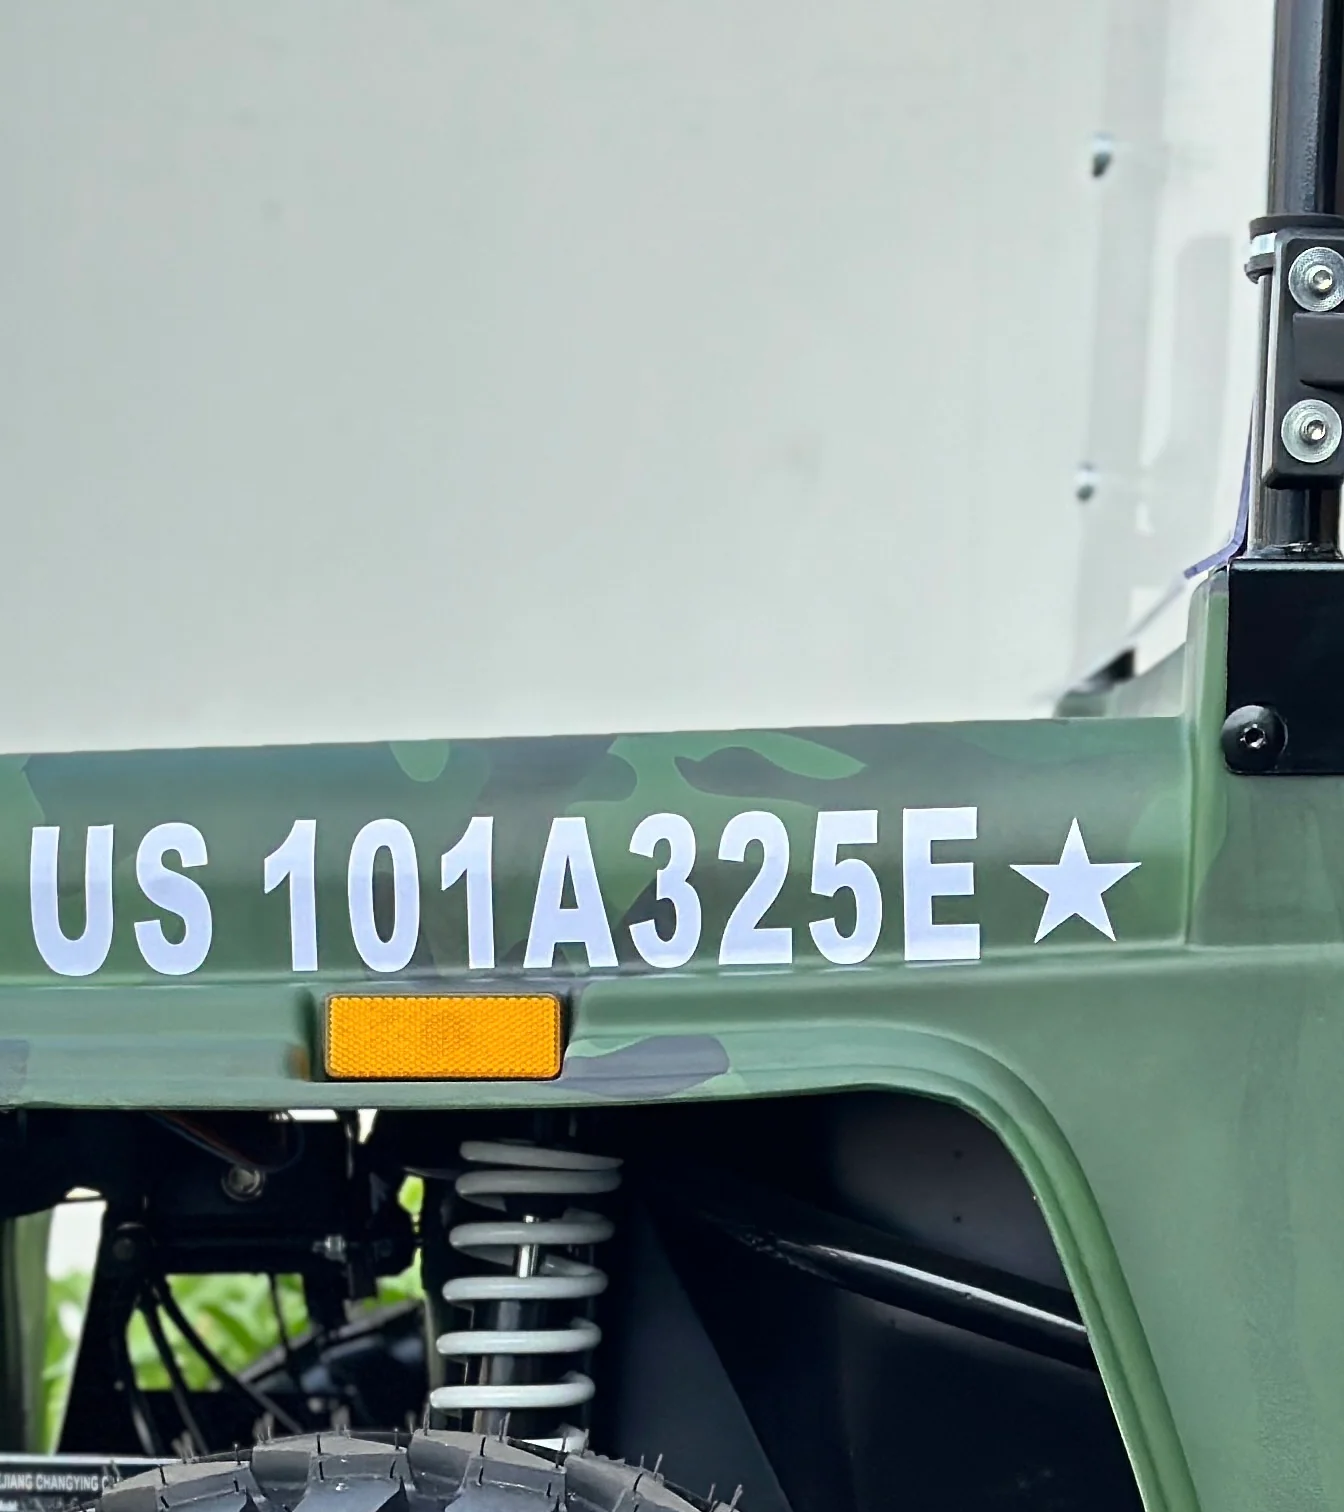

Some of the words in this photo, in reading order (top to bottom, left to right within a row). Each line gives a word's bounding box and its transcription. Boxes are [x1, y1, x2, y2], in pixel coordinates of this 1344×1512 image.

[29, 822, 214, 977] US
[263, 806, 982, 973] 101A325E
[36, 1473, 99, 1492] CHANGYING
